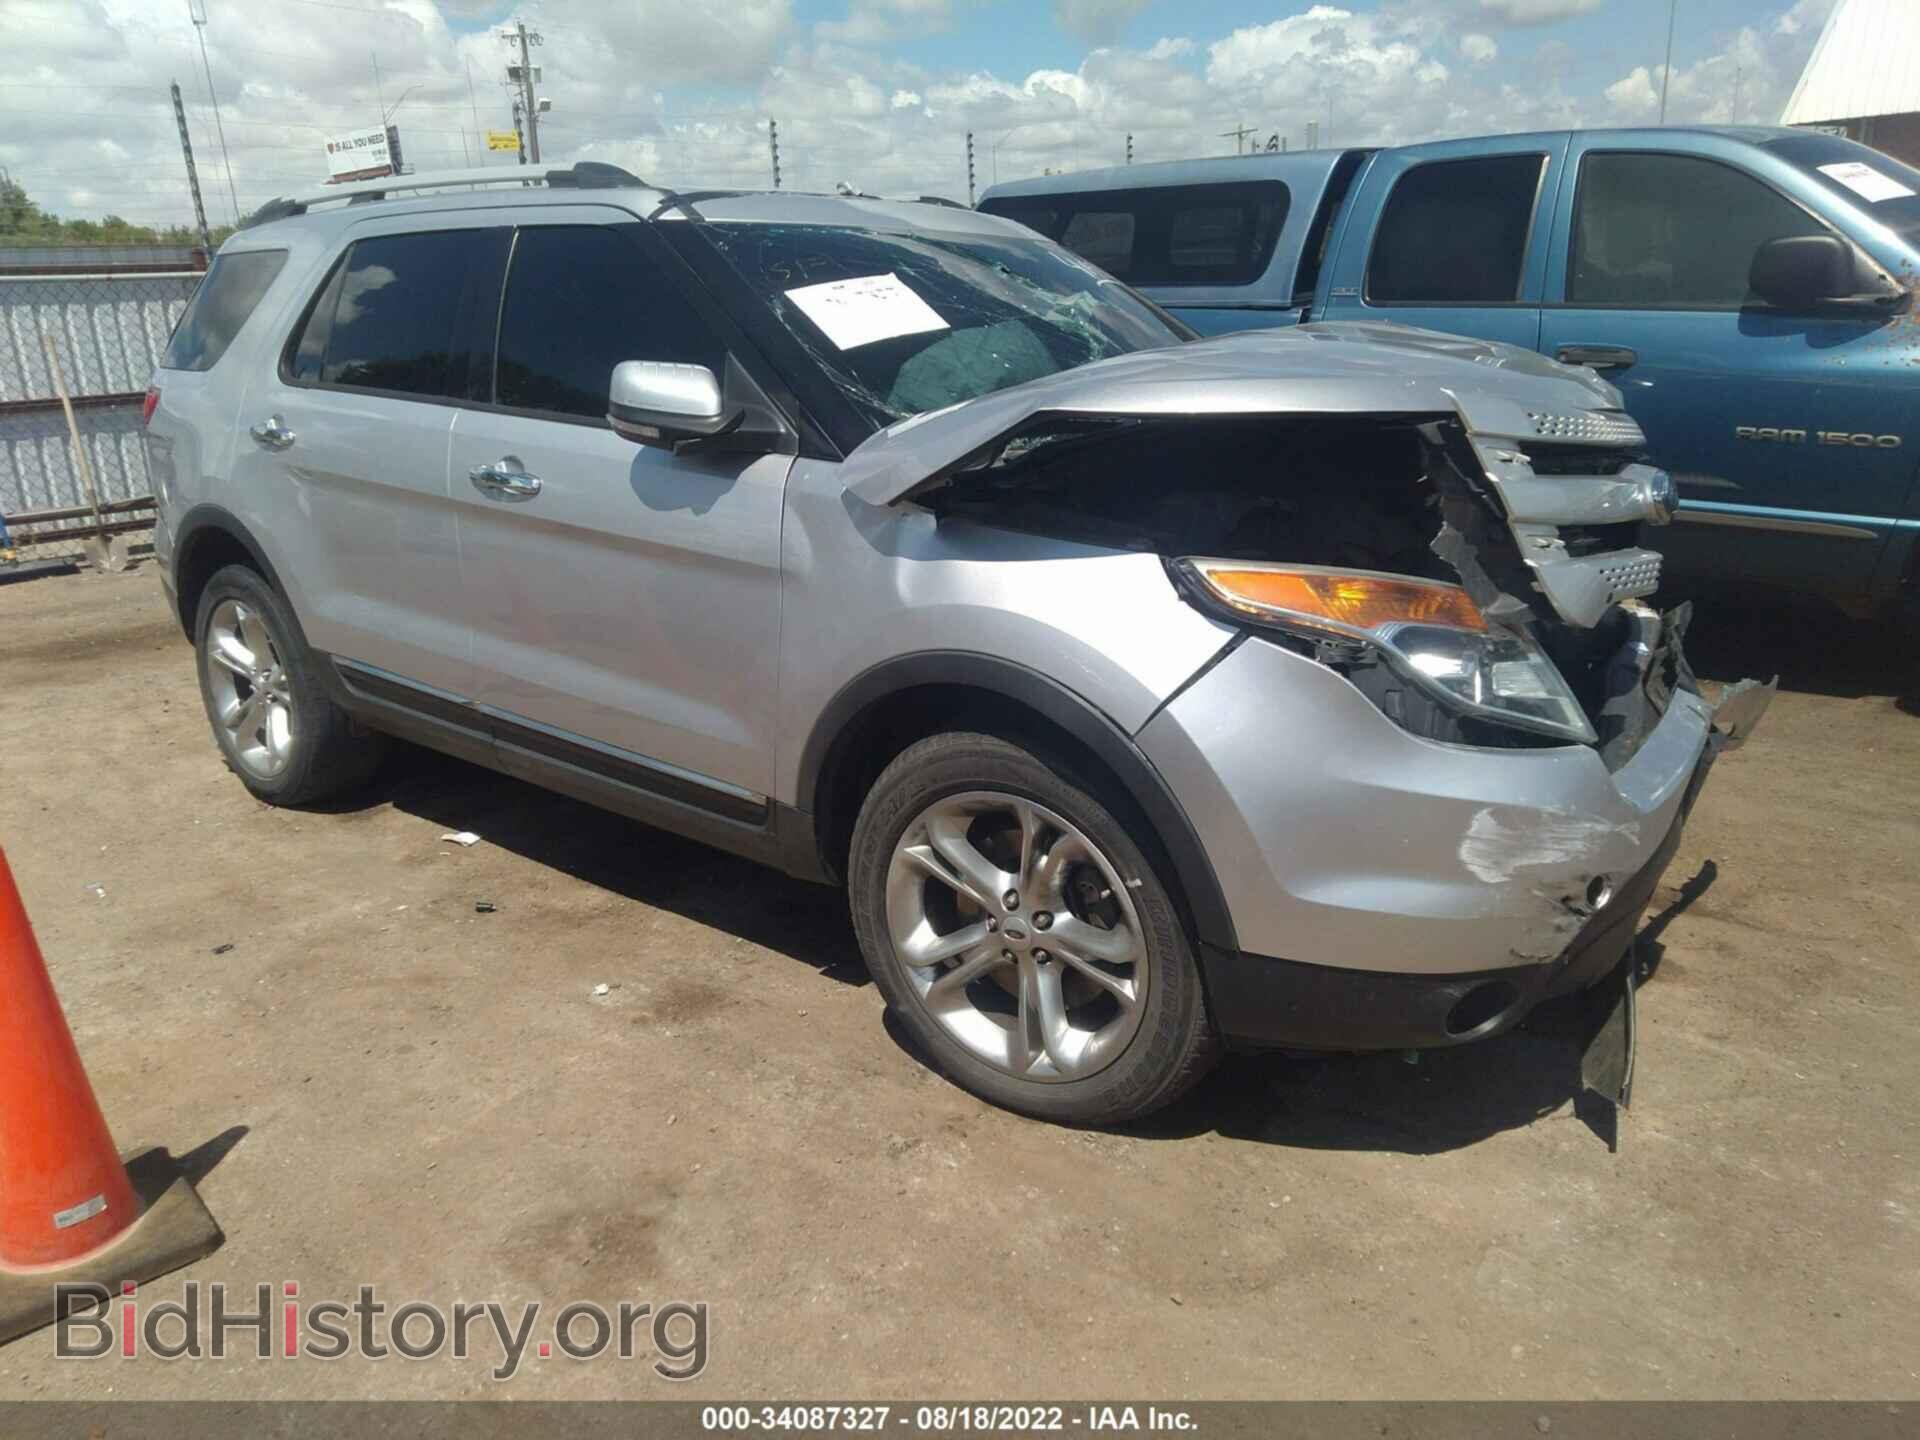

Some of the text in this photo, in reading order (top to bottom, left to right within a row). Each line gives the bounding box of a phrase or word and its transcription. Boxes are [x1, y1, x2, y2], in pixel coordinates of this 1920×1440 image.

[342, 140, 353, 150] ALL
[353, 136, 367, 148] YOU
[368, 133, 385, 145] NEED
[1736, 426, 1901, 448] RAM 1500
